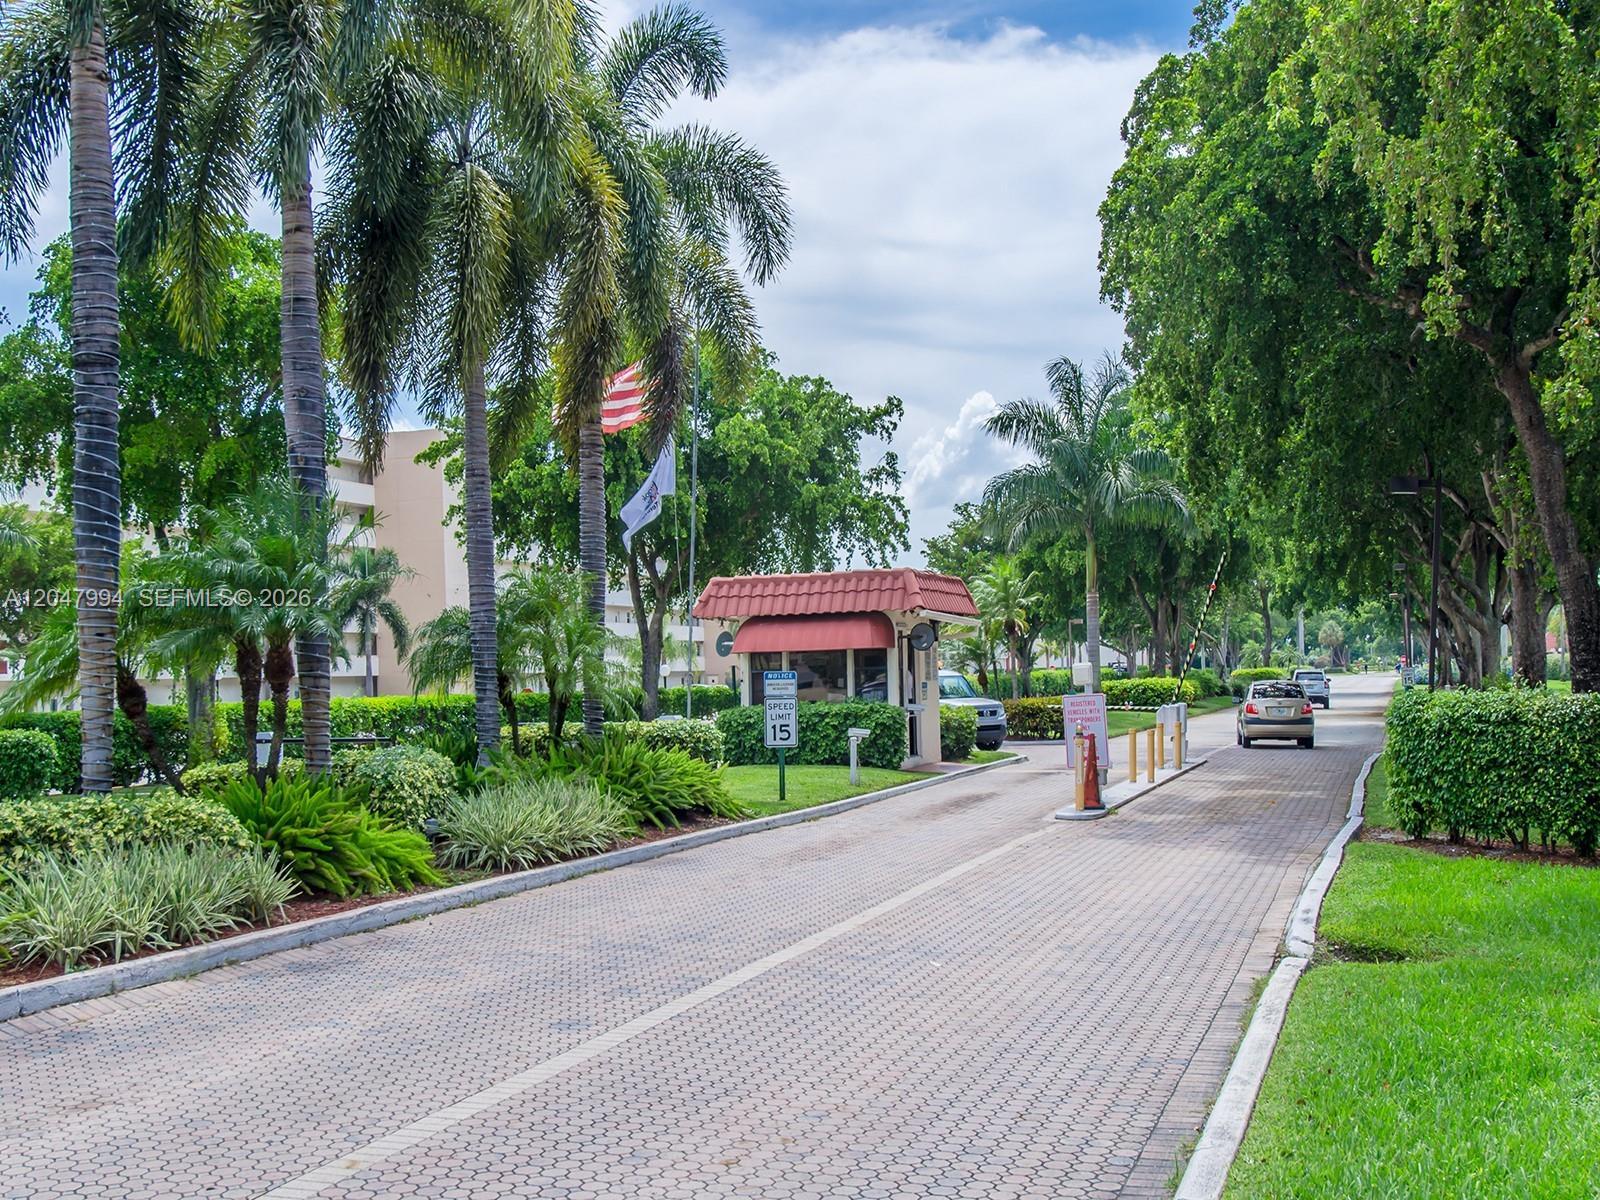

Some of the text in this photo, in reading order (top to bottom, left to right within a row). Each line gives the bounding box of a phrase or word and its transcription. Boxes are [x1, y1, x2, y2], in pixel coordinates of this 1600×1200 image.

[767, 702, 795, 711] SPEED
[770, 712, 792, 721] LIMIT
[771, 723, 791, 741] 15
